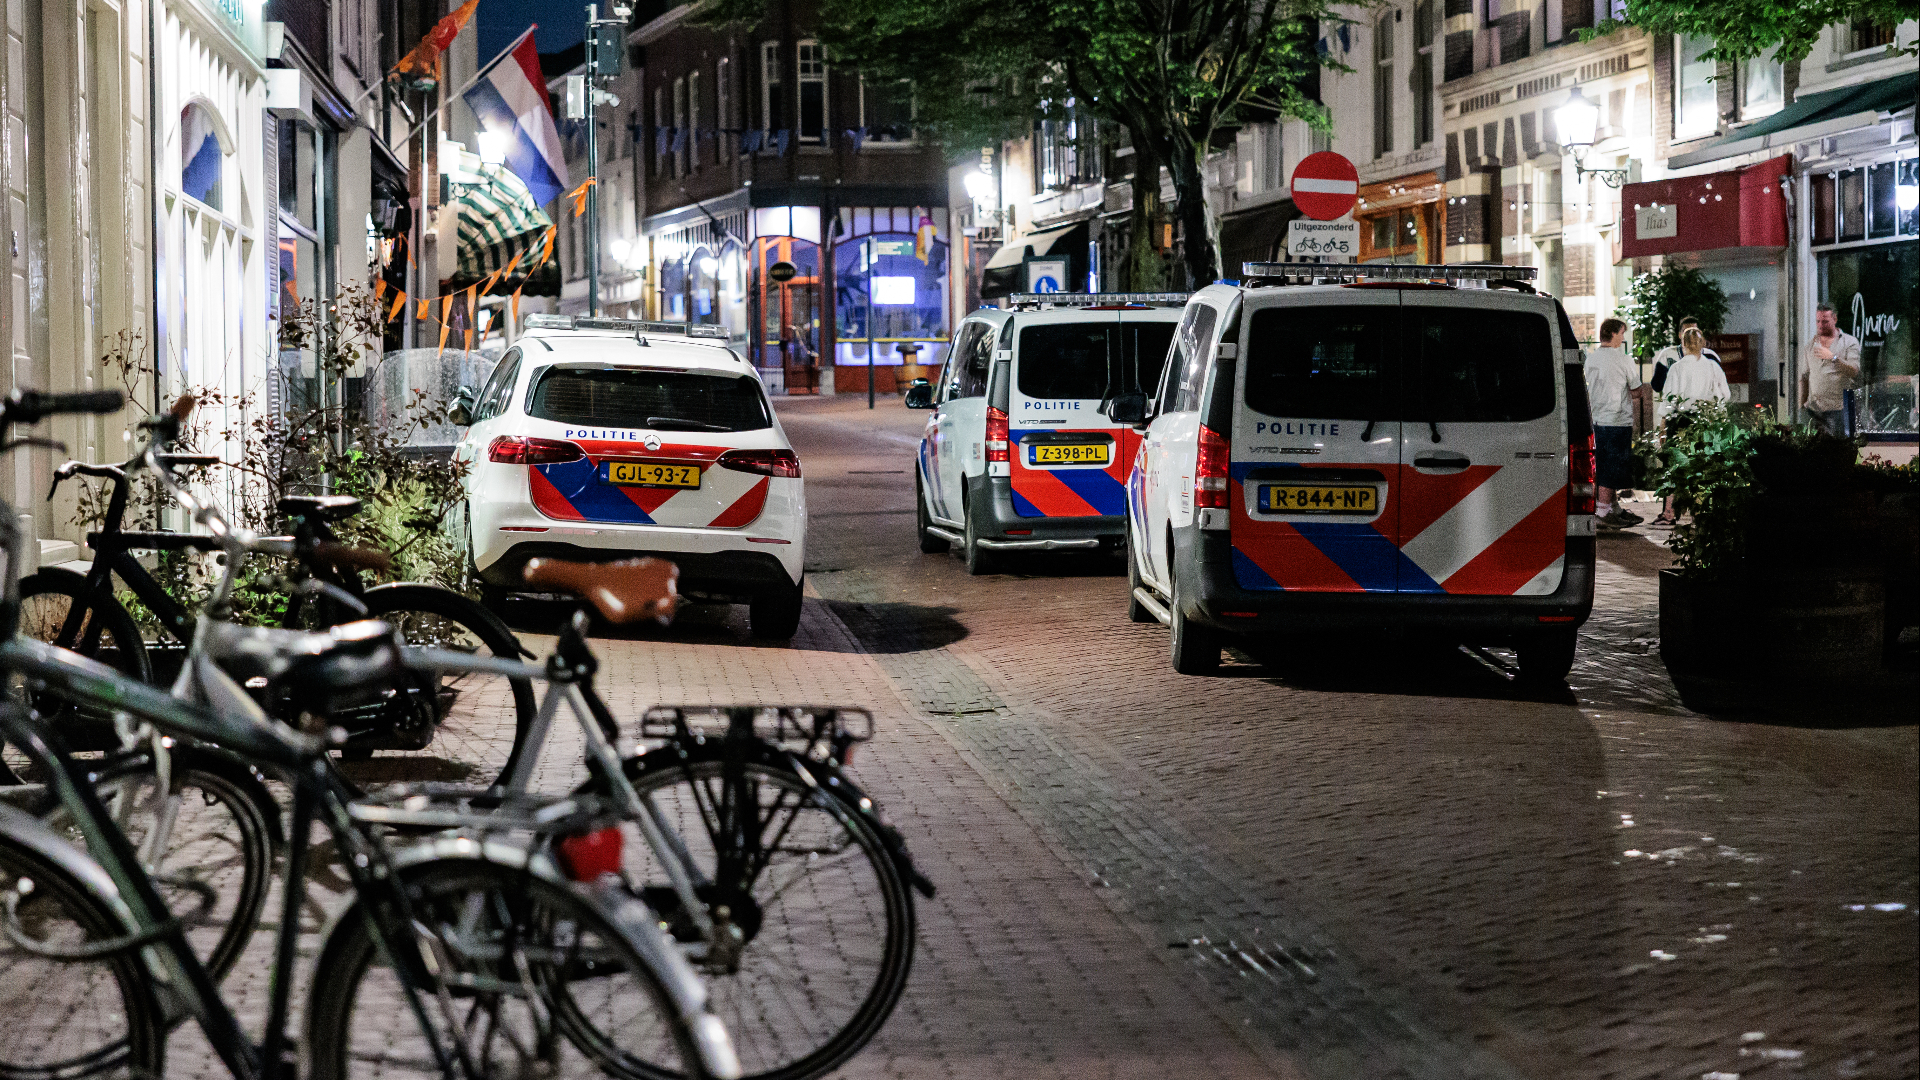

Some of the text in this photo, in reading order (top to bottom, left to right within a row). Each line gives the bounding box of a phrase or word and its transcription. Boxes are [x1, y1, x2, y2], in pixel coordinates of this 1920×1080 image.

[1294, 222, 1354, 232] Uitgezonderd
[1025, 401, 1081, 410] POLITIE
[565, 430, 637, 440] POLITIE
[1256, 421, 1339, 436] POLITIE
[1042, 447, 1102, 460] Z-398-PL
[616, 465, 690, 484] GJL-93-Z
[1276, 489, 1370, 508] R-844-NP
